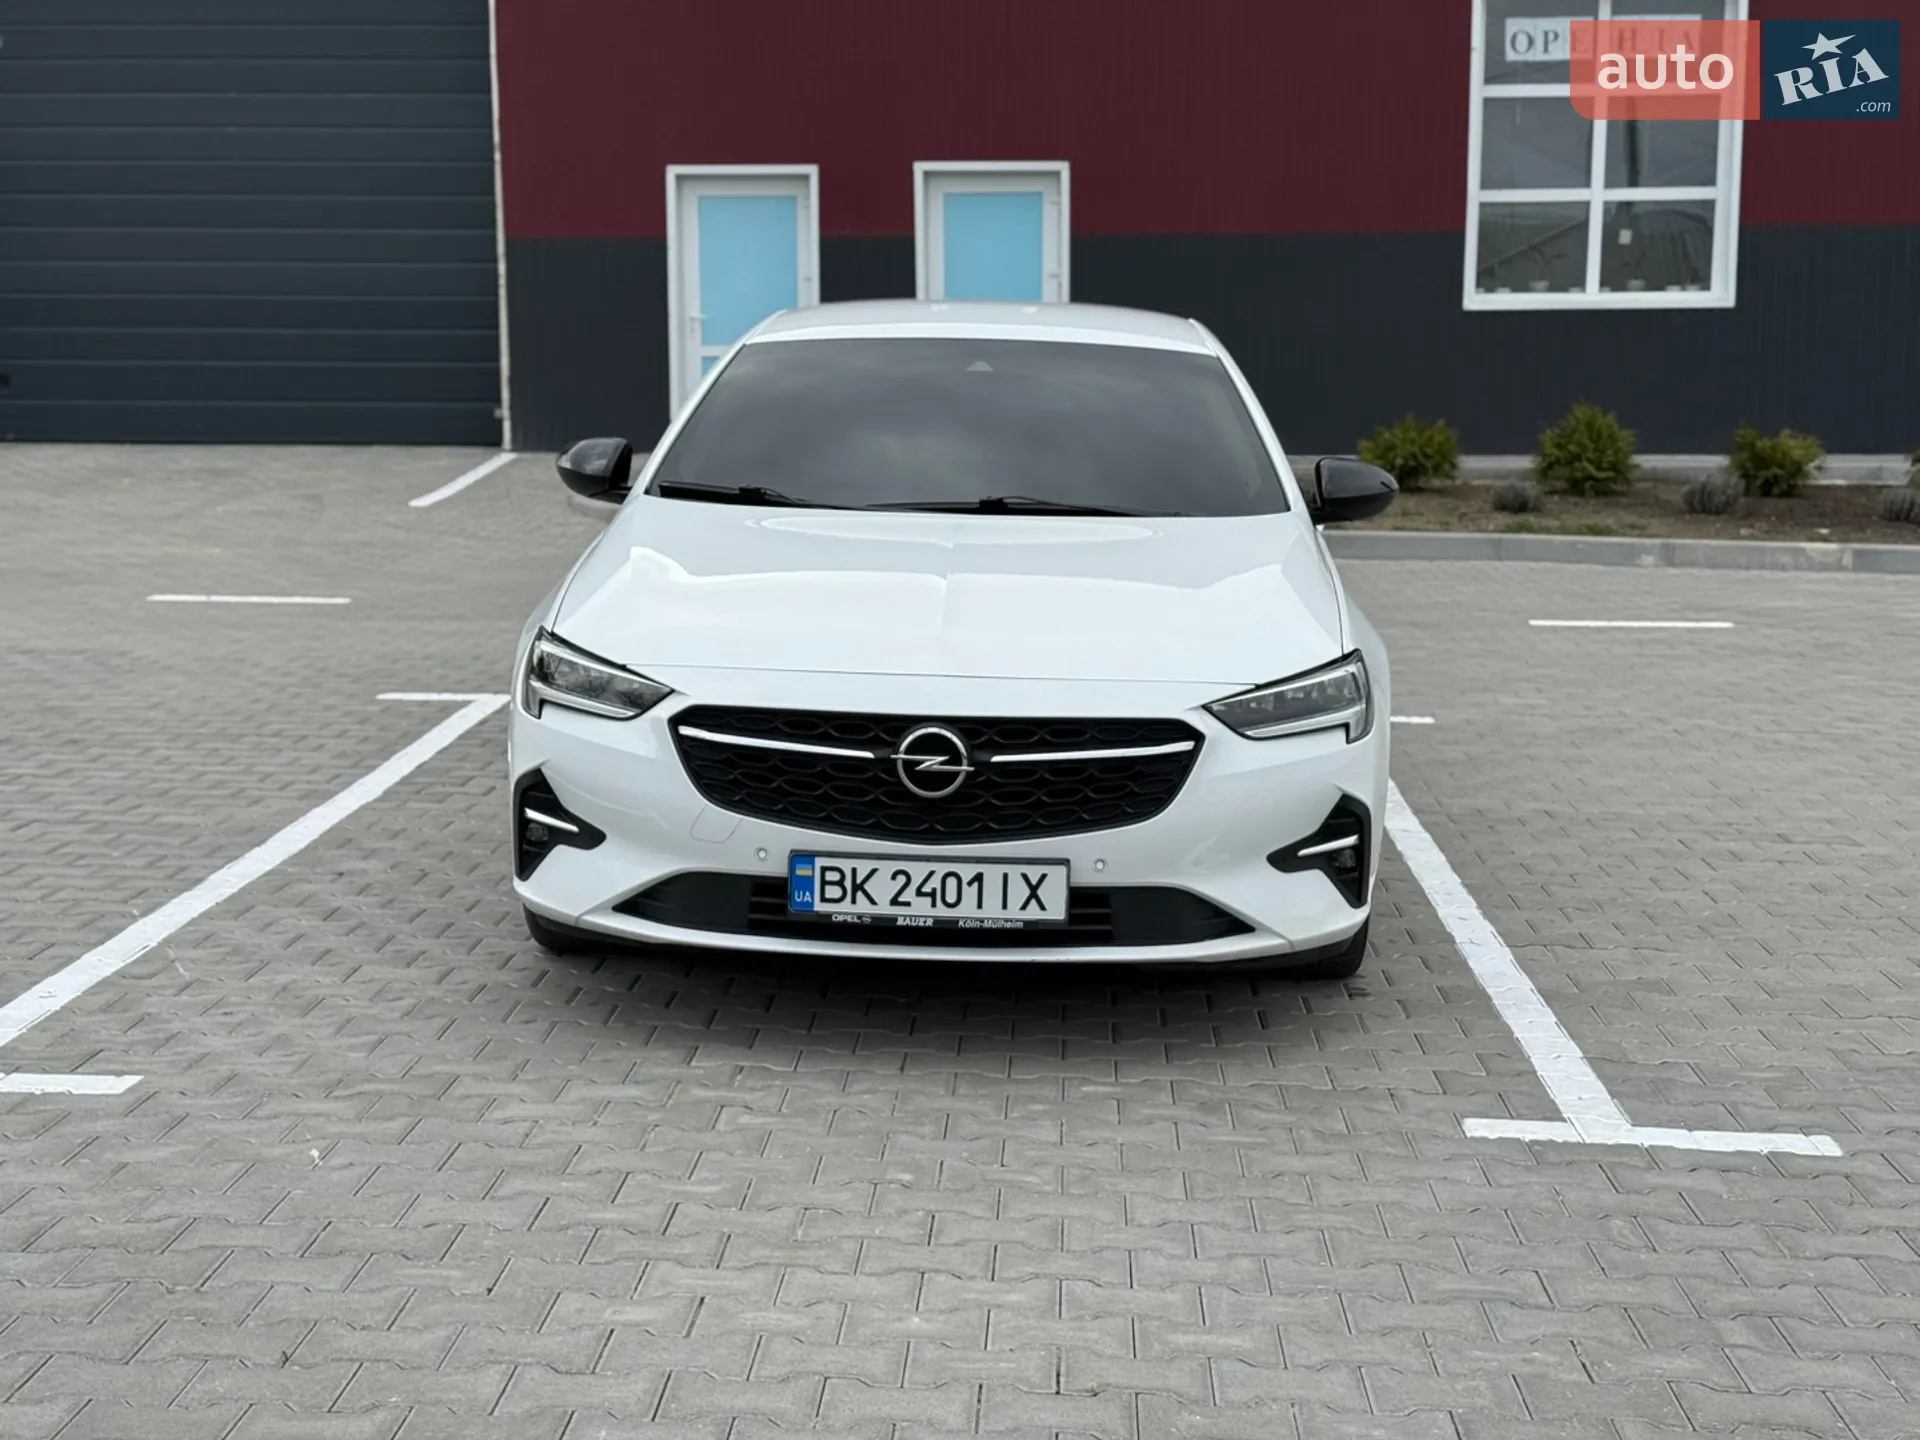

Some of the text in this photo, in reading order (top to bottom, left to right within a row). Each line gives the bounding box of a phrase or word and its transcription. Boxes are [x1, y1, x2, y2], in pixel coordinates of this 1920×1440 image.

[819, 865, 1048, 911] BK 2401 IX
[794, 889, 812, 904] UA
[832, 914, 1024, 929] OPEL BAUER Köln-Mülheim
